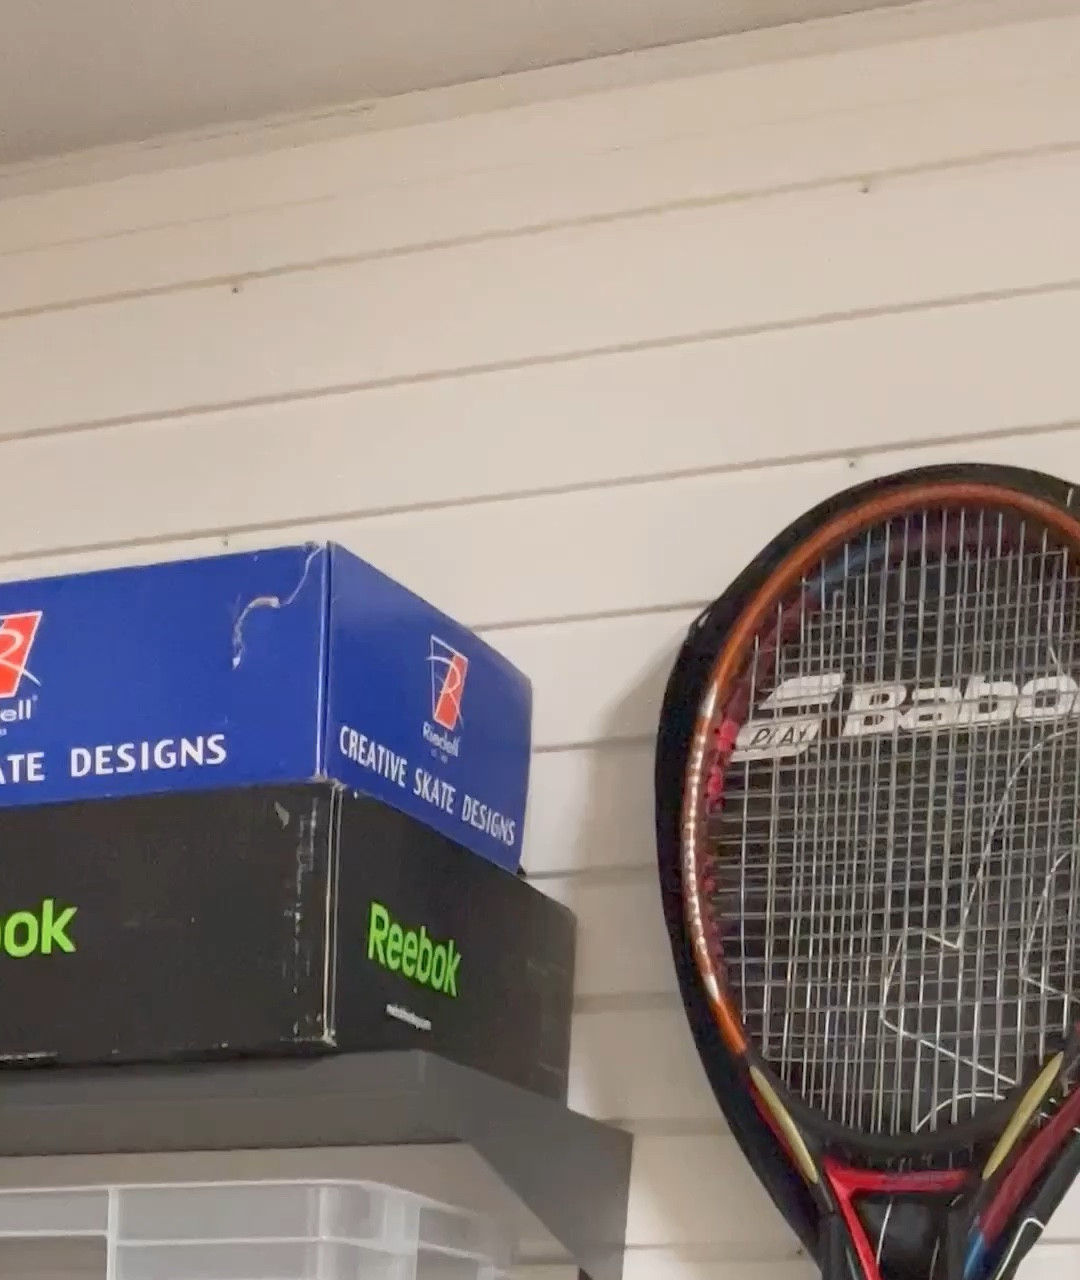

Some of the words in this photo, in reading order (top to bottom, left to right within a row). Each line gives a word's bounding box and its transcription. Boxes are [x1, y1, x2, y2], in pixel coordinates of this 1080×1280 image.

[69, 733, 228, 779] DESIGNS
[422, 720, 461, 758] Riedell
[339, 725, 408, 788] CREATIVE
[412, 767, 457, 815] SKATE
[461, 793, 516, 847] DESIGNS
[367, 900, 462, 998] Reebok
